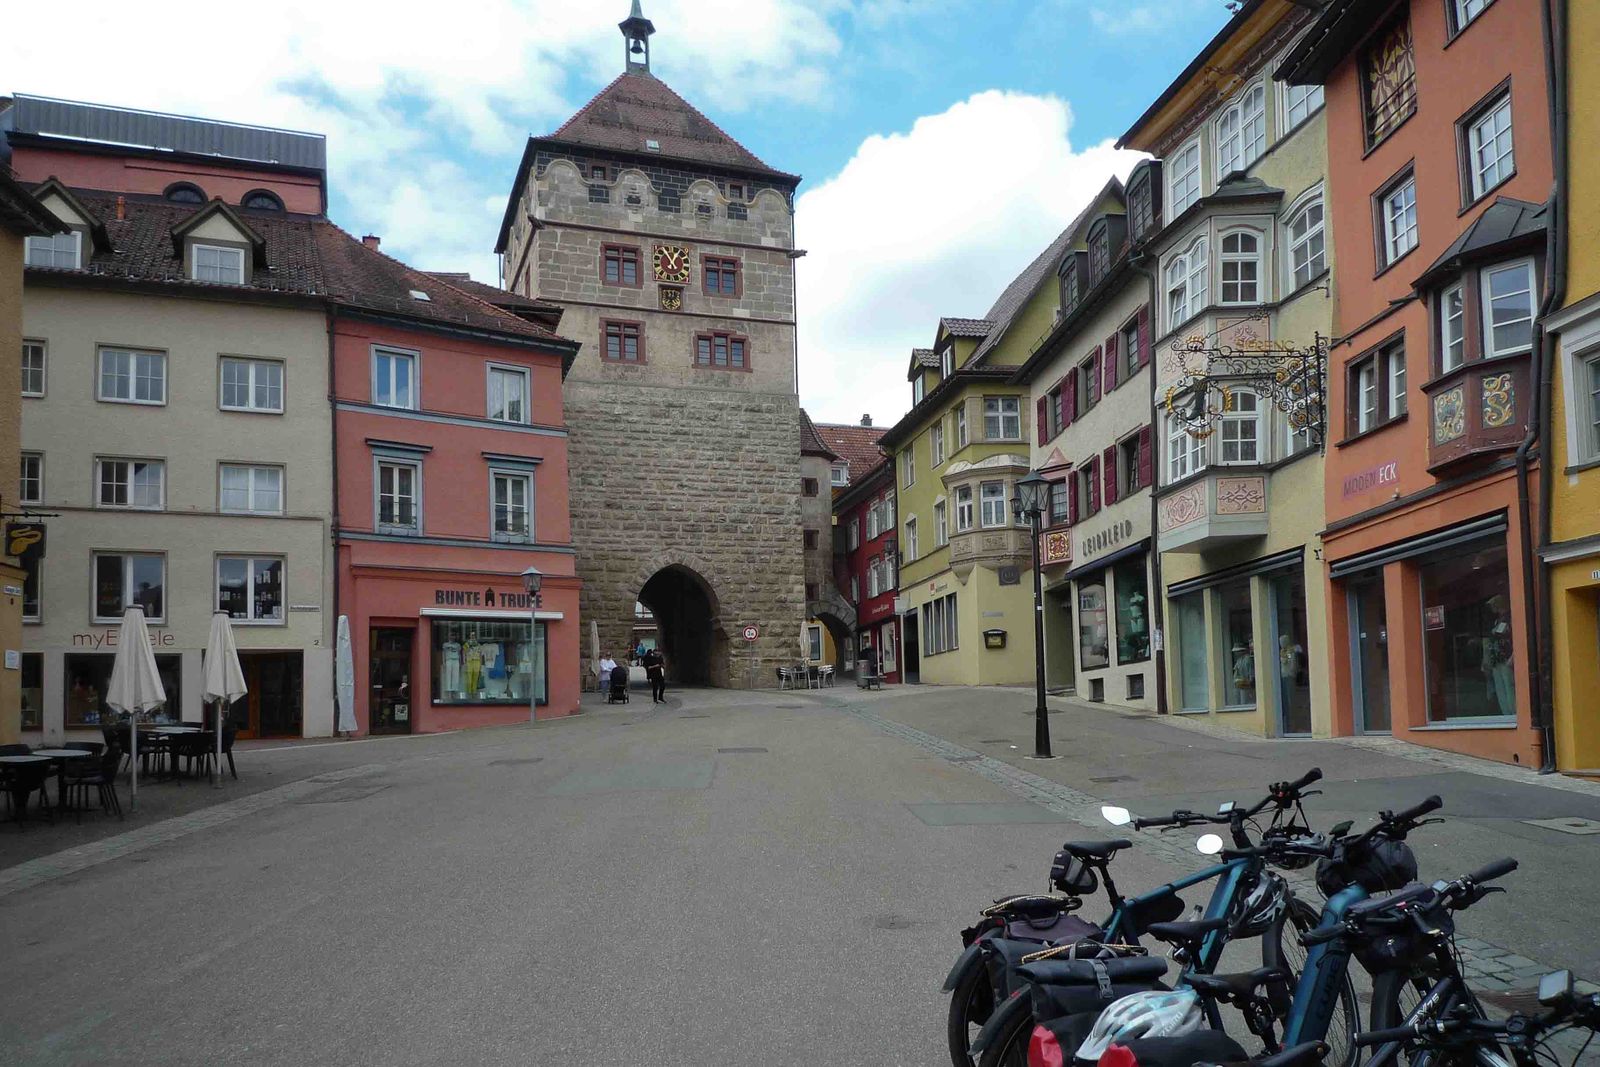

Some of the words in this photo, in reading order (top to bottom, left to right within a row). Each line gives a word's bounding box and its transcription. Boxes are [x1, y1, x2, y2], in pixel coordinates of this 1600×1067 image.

[1379, 462, 1397, 484] ECK
[1082, 520, 1132, 557] LEIBKLEID
[435, 589, 481, 606] BUNTE
